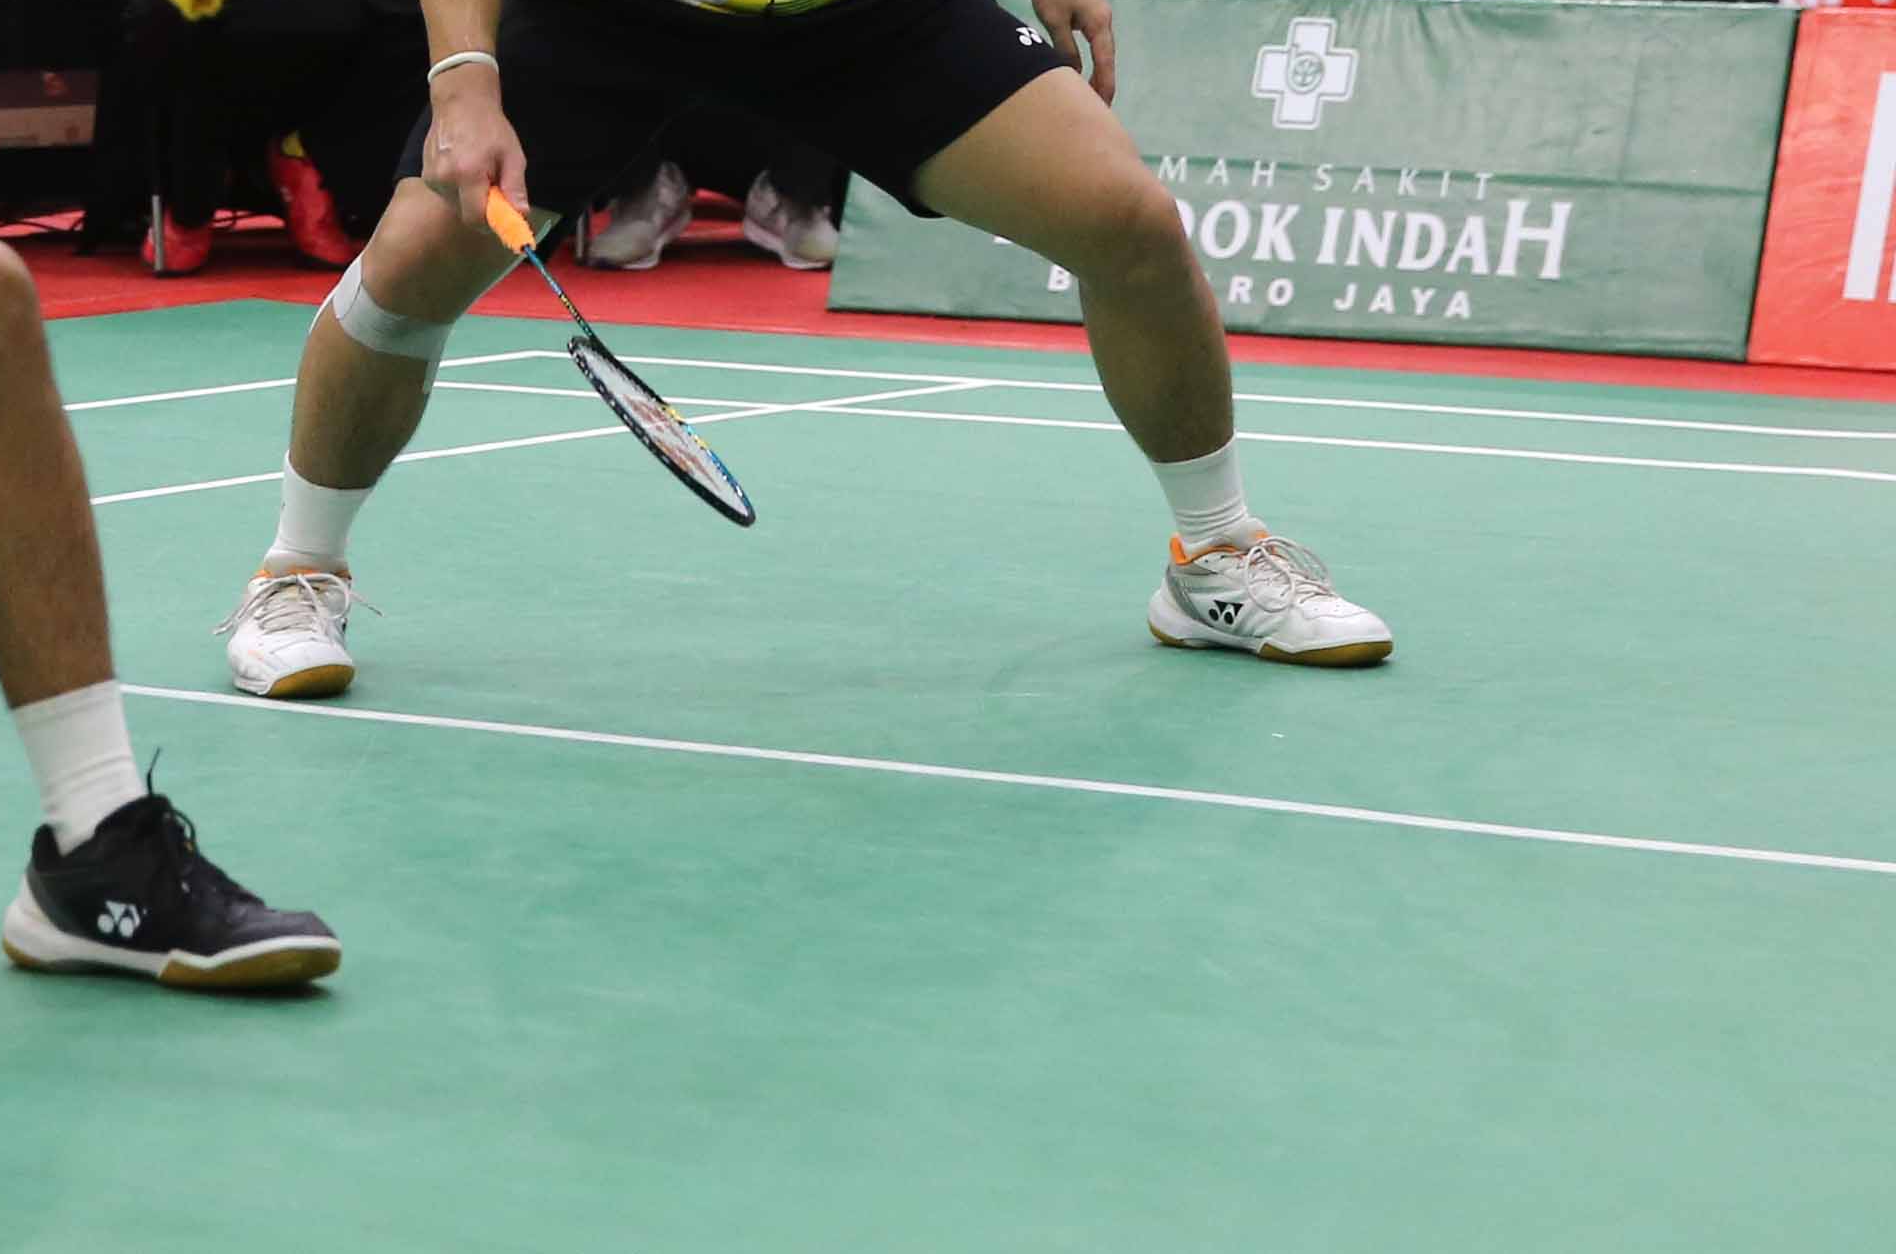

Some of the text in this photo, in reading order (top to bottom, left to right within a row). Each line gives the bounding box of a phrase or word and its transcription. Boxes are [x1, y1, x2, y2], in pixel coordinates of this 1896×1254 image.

[1157, 155, 1494, 201] MAH SAKIT
[1315, 199, 1573, 280] INDAH
[1334, 282, 1473, 320] JAYA
